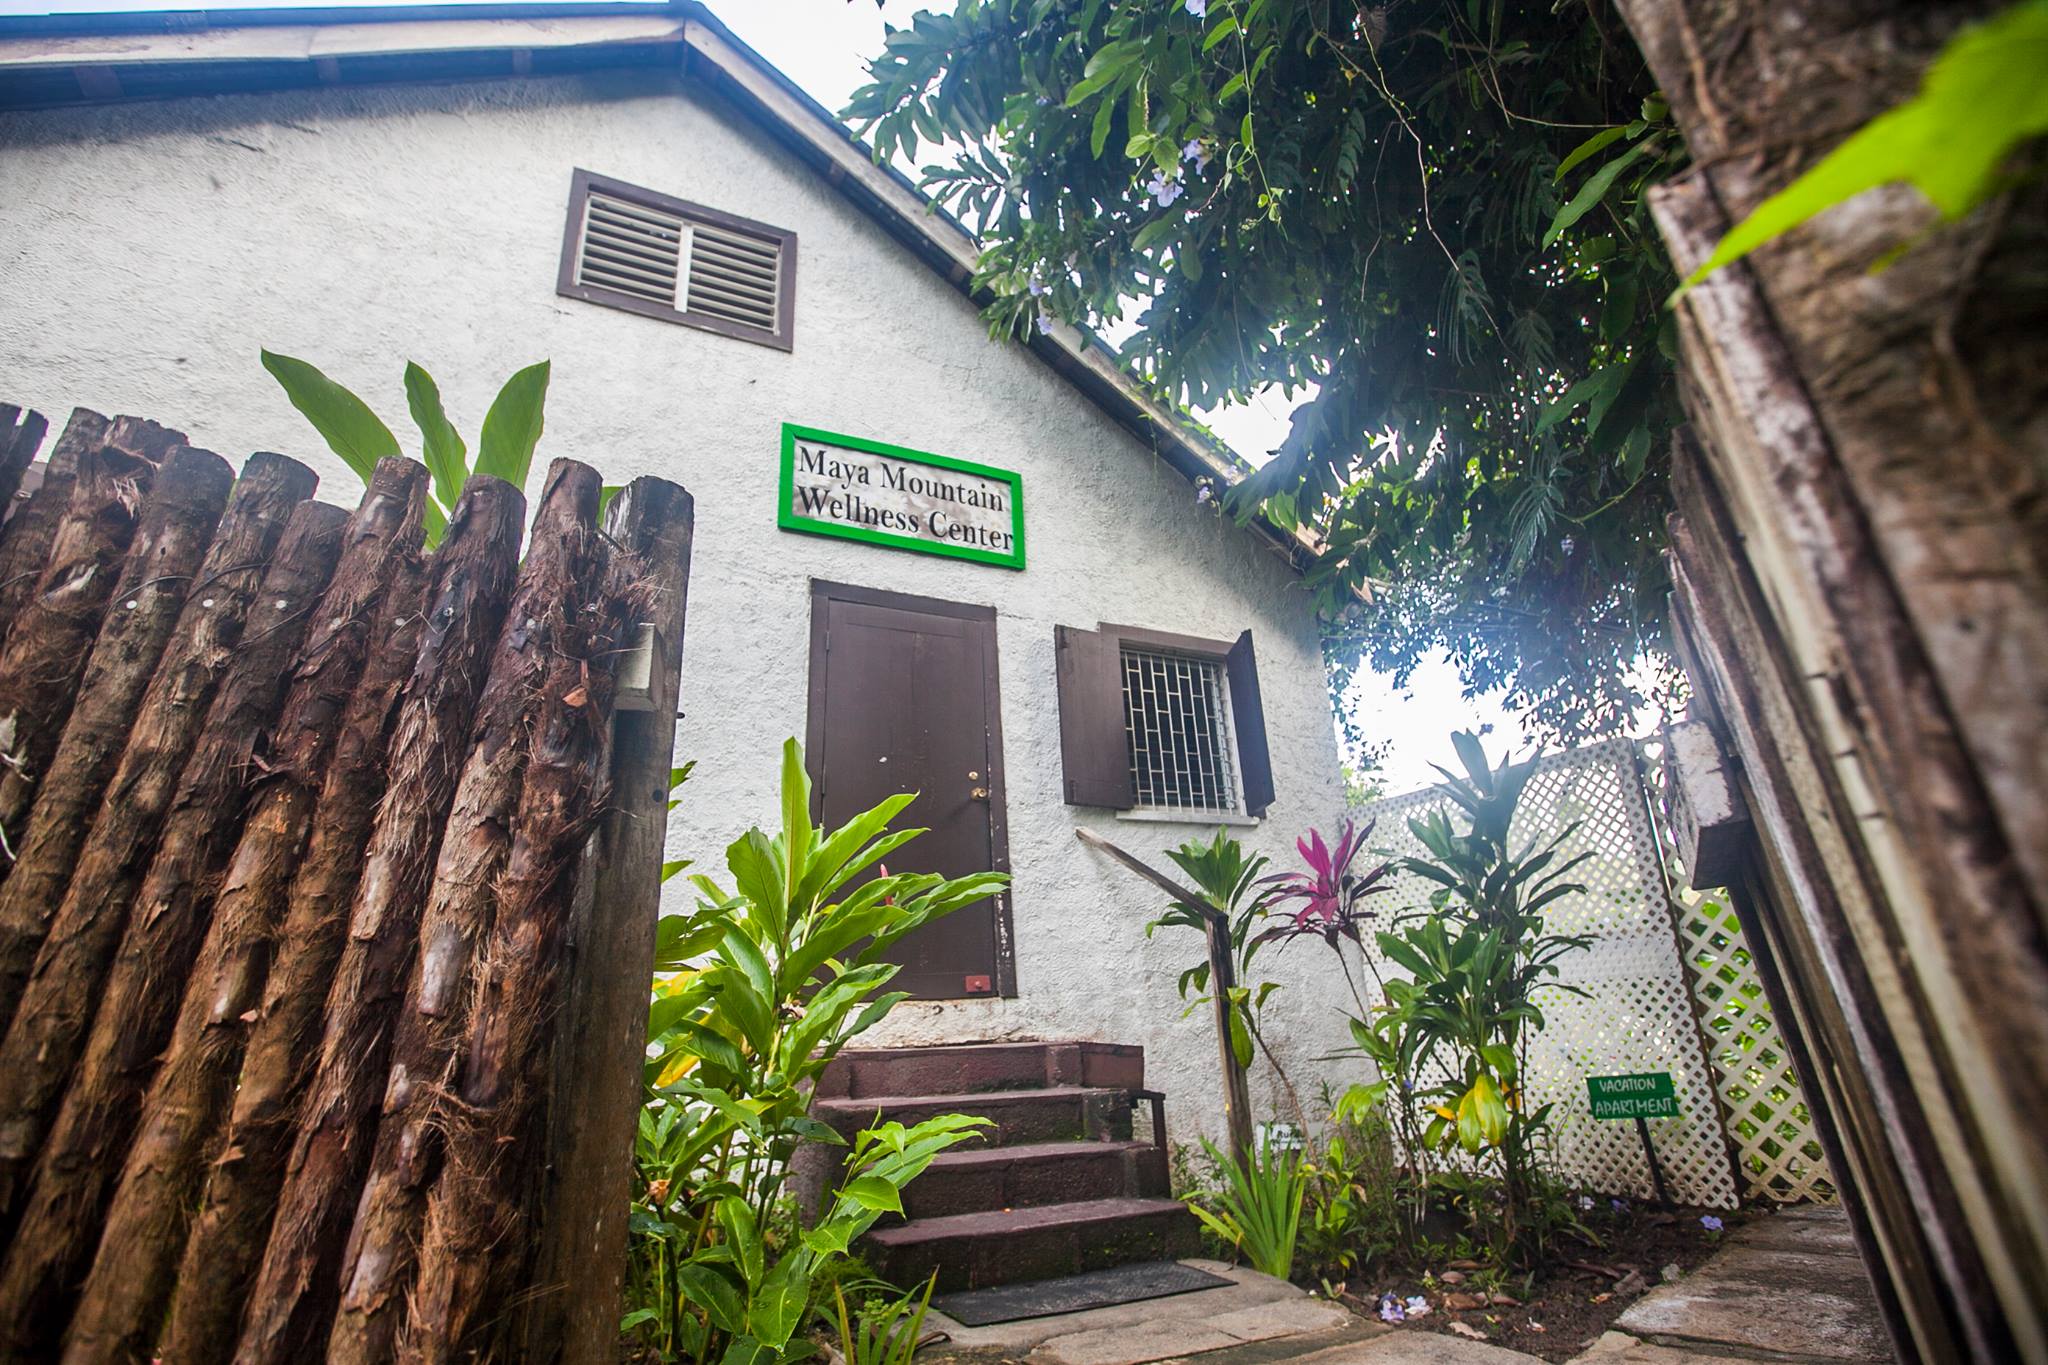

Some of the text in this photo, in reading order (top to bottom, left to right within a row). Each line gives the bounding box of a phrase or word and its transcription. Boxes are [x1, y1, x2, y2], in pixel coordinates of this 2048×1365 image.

[799, 447, 1004, 511] Maya Mountain
[798, 485, 1014, 550] Wellness Center
[1599, 1077, 1656, 1093] VACATION
[1595, 1097, 1672, 1116] APARTMENT
